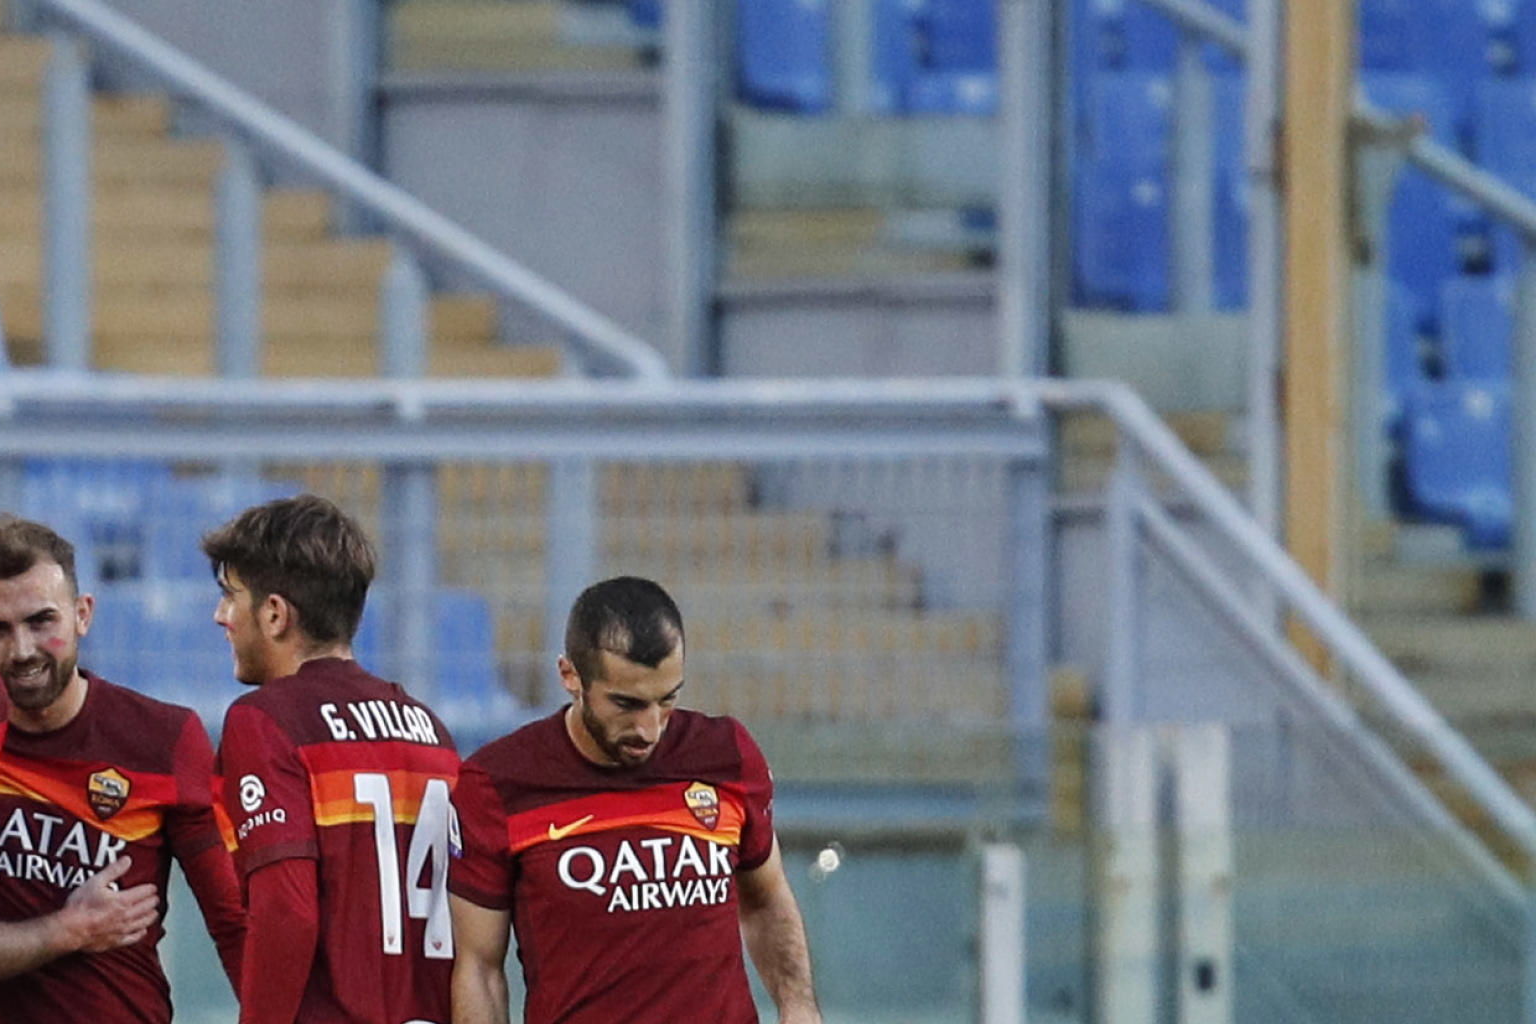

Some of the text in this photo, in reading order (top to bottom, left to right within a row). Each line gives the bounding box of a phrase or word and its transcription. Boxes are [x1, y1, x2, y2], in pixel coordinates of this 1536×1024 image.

[320, 700, 440, 744] G.VILLAR
[353, 773, 454, 960] 14
[557, 835, 732, 896] QATAR
[607, 878, 730, 913] AIRWAYS
